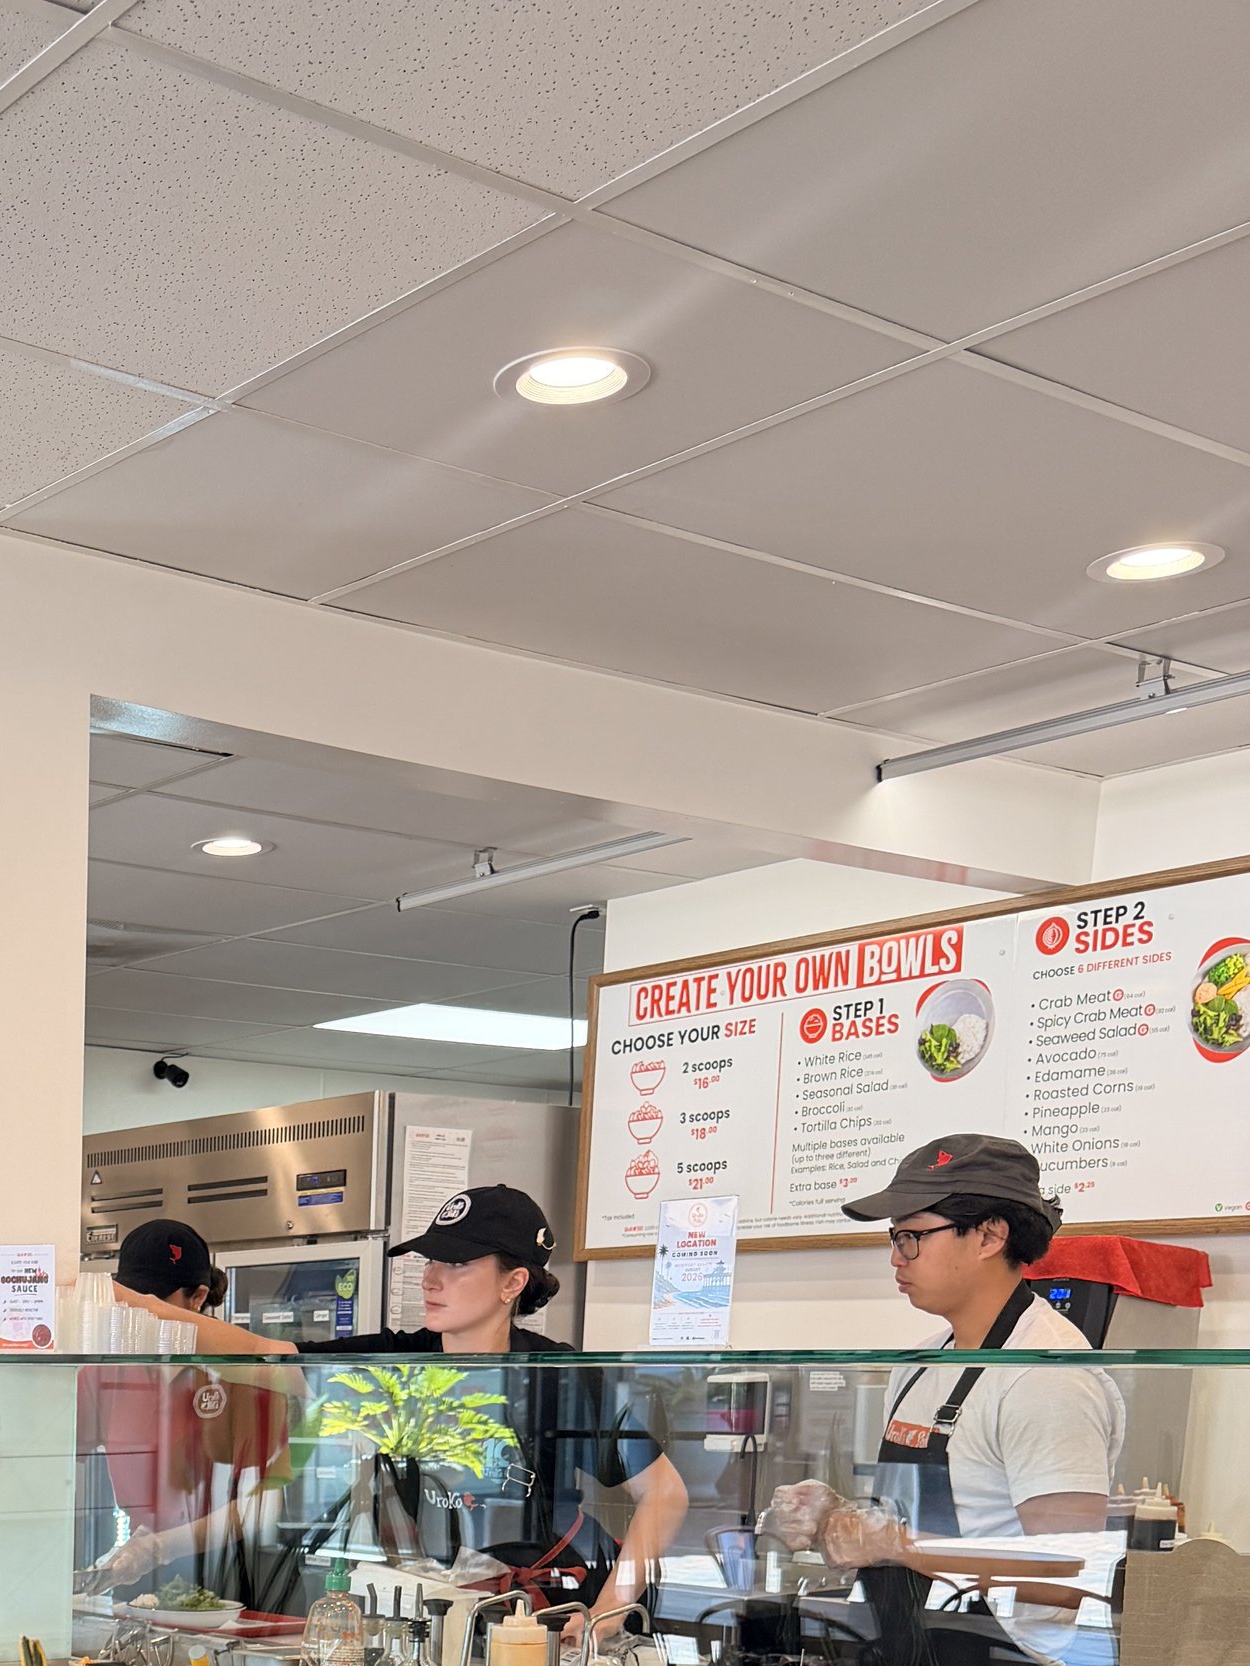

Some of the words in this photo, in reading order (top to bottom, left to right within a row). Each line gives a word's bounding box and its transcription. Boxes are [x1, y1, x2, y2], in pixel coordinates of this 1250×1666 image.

[1076, 905, 1127, 929] STEP
[1133, 901, 1145, 920] 2
[1075, 921, 1154, 954] SIDES
[1033, 966, 1075, 980] CHOOSE
[1078, 964, 1083, 973] 6
[1087, 956, 1140, 972] DIFFERENT
[1142, 952, 1172, 964] SIDES
[636, 974, 719, 1020] CREATE
[726, 962, 787, 1005] YOUR
[795, 949, 850, 994] OWN
[863, 930, 958, 984] BOWLS
[1039, 995, 1072, 1010] Crab
[1076, 991, 1111, 1006] Meat
[833, 1000, 874, 1021] STEP
[878, 998, 884, 1014] 1
[1038, 1014, 1071, 1031] Spicy
[1074, 1009, 1106, 1024] Crab
[1110, 1005, 1142, 1020] Meat
[612, 1032, 674, 1054] CHOOSE
[678, 1025, 720, 1044] YOUR
[724, 1018, 756, 1038] SIZE
[832, 1014, 900, 1042] BASES
[1036, 1028, 1096, 1046] Seaweed
[1099, 1023, 1137, 1039] Salad
[805, 1054, 835, 1067] White
[839, 1051, 861, 1062] Rice
[1036, 1048, 1096, 1064] Avocado
[682, 1062, 689, 1073] 2
[692, 1058, 732, 1072] scoops
[694, 1075, 720, 1089] $16.00
[803, 1072, 836, 1084] Brown
[840, 1067, 863, 1080] Rice
[1035, 1066, 1106, 1082] Edamame
[802, 1084, 853, 1100] Seasonal
[856, 1079, 889, 1093] Salad
[1034, 1084, 1089, 1100] Roasted
[1093, 1082, 1134, 1094] Corns
[680, 1113, 686, 1124] 3
[689, 1109, 730, 1123] scoops
[802, 1101, 845, 1117] Broccoli
[1033, 1102, 1099, 1118] Pineapple
[802, 1120, 836, 1133] Tortilla
[840, 1116, 872, 1130] Chips
[1032, 1124, 1078, 1138] Mango
[691, 1126, 717, 1140] $18.00
[792, 1141, 827, 1153] Multiple
[830, 1139, 857, 1148] bases
[860, 1133, 904, 1146] available
[1031, 1141, 1068, 1154] White
[1072, 1138, 1119, 1151] Onions
[806, 1154, 813, 1162] to
[815, 1152, 834, 1161] three
[836, 1147, 871, 1159] different)
[677, 1163, 683, 1174] 5
[686, 1160, 727, 1174] scoops
[847, 1160, 869, 1169] Salad
[871, 1158, 886, 1167] and
[1040, 1158, 1108, 1172] ucumbers
[689, 1177, 714, 1190] $21.00
[790, 1183, 811, 1192] Extra
[814, 1181, 837, 1190] base
[1048, 1184, 1070, 1194] side
[1074, 1182, 1095, 1192] $2.25
[677, 1239, 716, 1248] LOCATION
